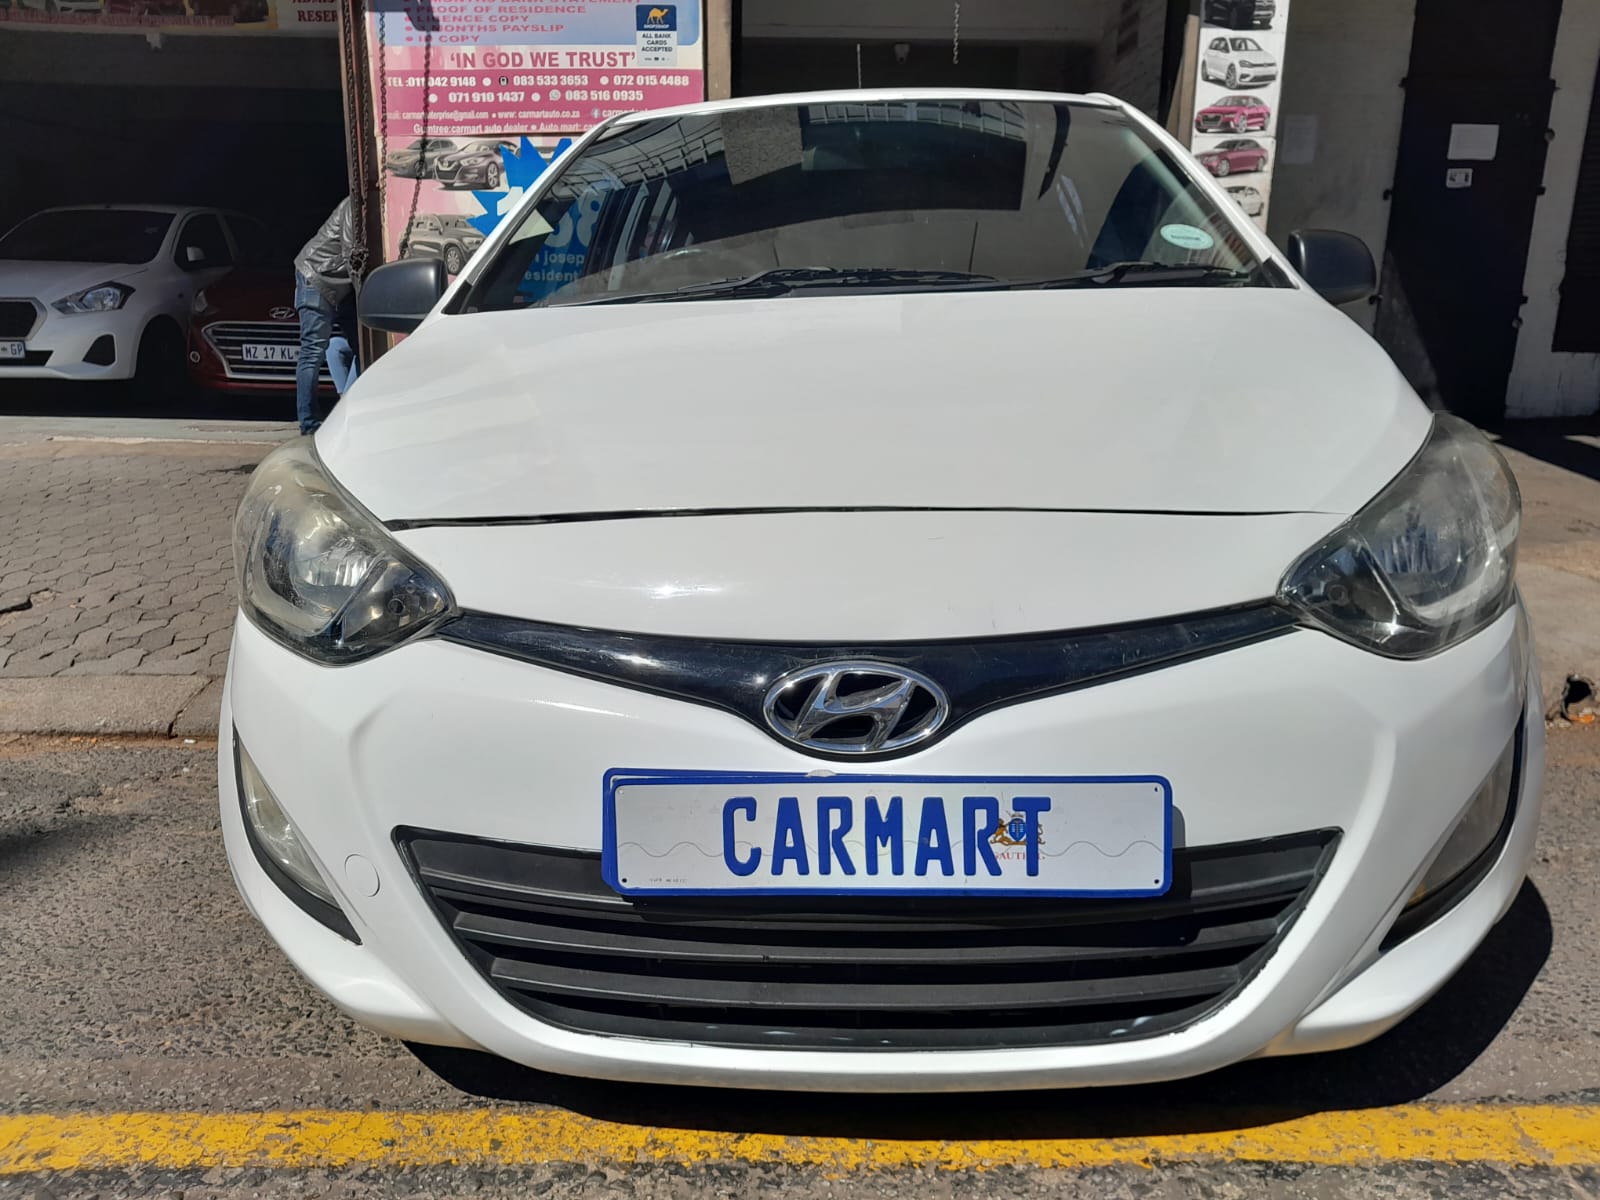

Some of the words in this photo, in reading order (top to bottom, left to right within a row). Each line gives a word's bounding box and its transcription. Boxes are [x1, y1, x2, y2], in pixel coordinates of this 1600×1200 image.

[502, 24, 565, 32] PAYSLIP
[483, 52, 523, 68] GOD
[530, 51, 560, 67] WE
[513, 75, 535, 86] 083
[536, 75, 558, 86] 533
[613, 74, 635, 86] 072
[636, 74, 658, 86] 015
[659, 75, 690, 87] 4488
[448, 92, 470, 103] 071
[496, 91, 525, 102] 1437
[565, 89, 588, 101] 083
[590, 89, 611, 101] 516
[612, 89, 644, 101] 0935
[10, 343, 23, 356] GP
[264, 347, 275, 359] 17
[280, 347, 294, 359] KL
[722, 796, 1052, 877] CARMART
